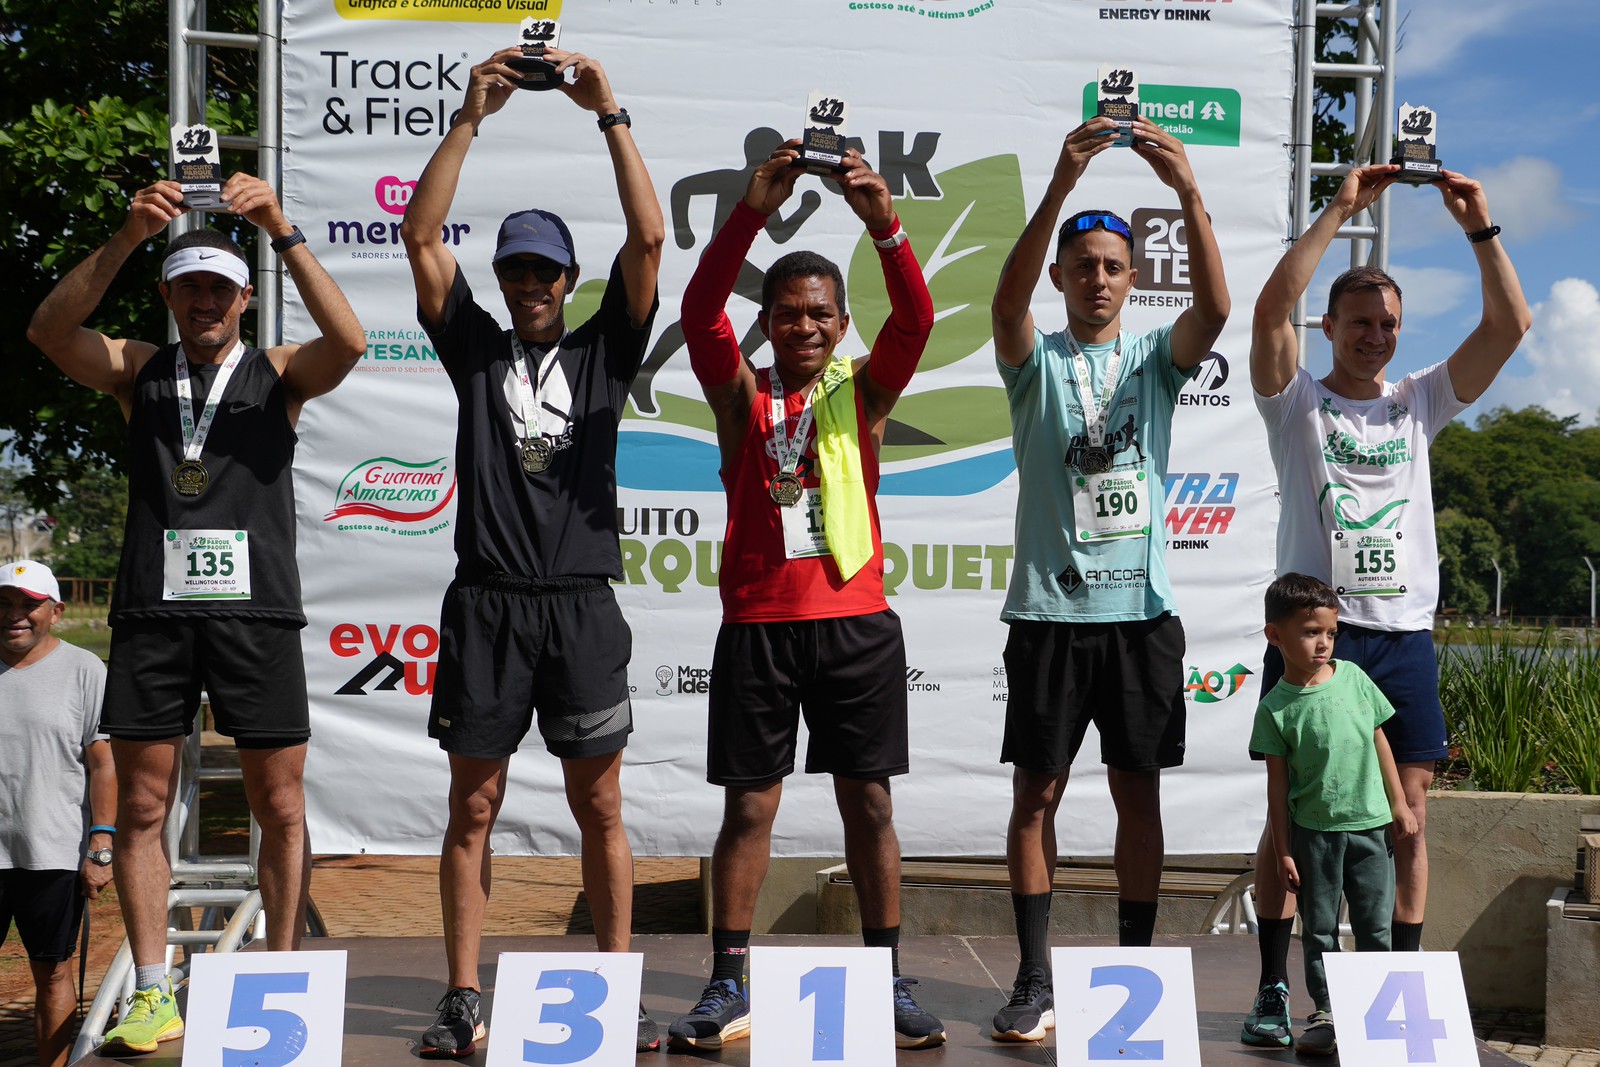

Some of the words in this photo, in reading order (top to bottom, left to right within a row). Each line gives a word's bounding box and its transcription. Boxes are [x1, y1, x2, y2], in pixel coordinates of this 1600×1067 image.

[849, 2, 894, 10] Gostoso
[897, 4, 915, 12] até
[928, 10, 965, 19] última
[1099, 8, 1160, 20] ENERGY
[1164, 9, 1211, 21] DRINK
[320, 51, 463, 91] Track
[322, 97, 354, 135] &
[1137, 100, 1194, 119] med
[351, 252, 390, 260] SABORES
[1175, 394, 1231, 407] ENTOS
[365, 466, 447, 485] Guaraná
[343, 481, 439, 502] Amazonas
[1095, 491, 1138, 518] 190
[374, 524, 388, 532] até
[398, 528, 427, 536] última
[428, 520, 450, 534] gota!
[1172, 540, 1210, 549] DRINK
[186, 551, 235, 577] 135
[610, 538, 724, 593] RQU
[1354, 549, 1396, 574] 155
[1085, 582, 1123, 590] PROTEÇÃO
[907, 683, 940, 692] UTION
[221, 972, 309, 1067] 5
[522, 968, 609, 1065] 3
[799, 966, 847, 1061] 1
[1087, 964, 1164, 1061] 2
[1365, 966, 1453, 1063] 4
